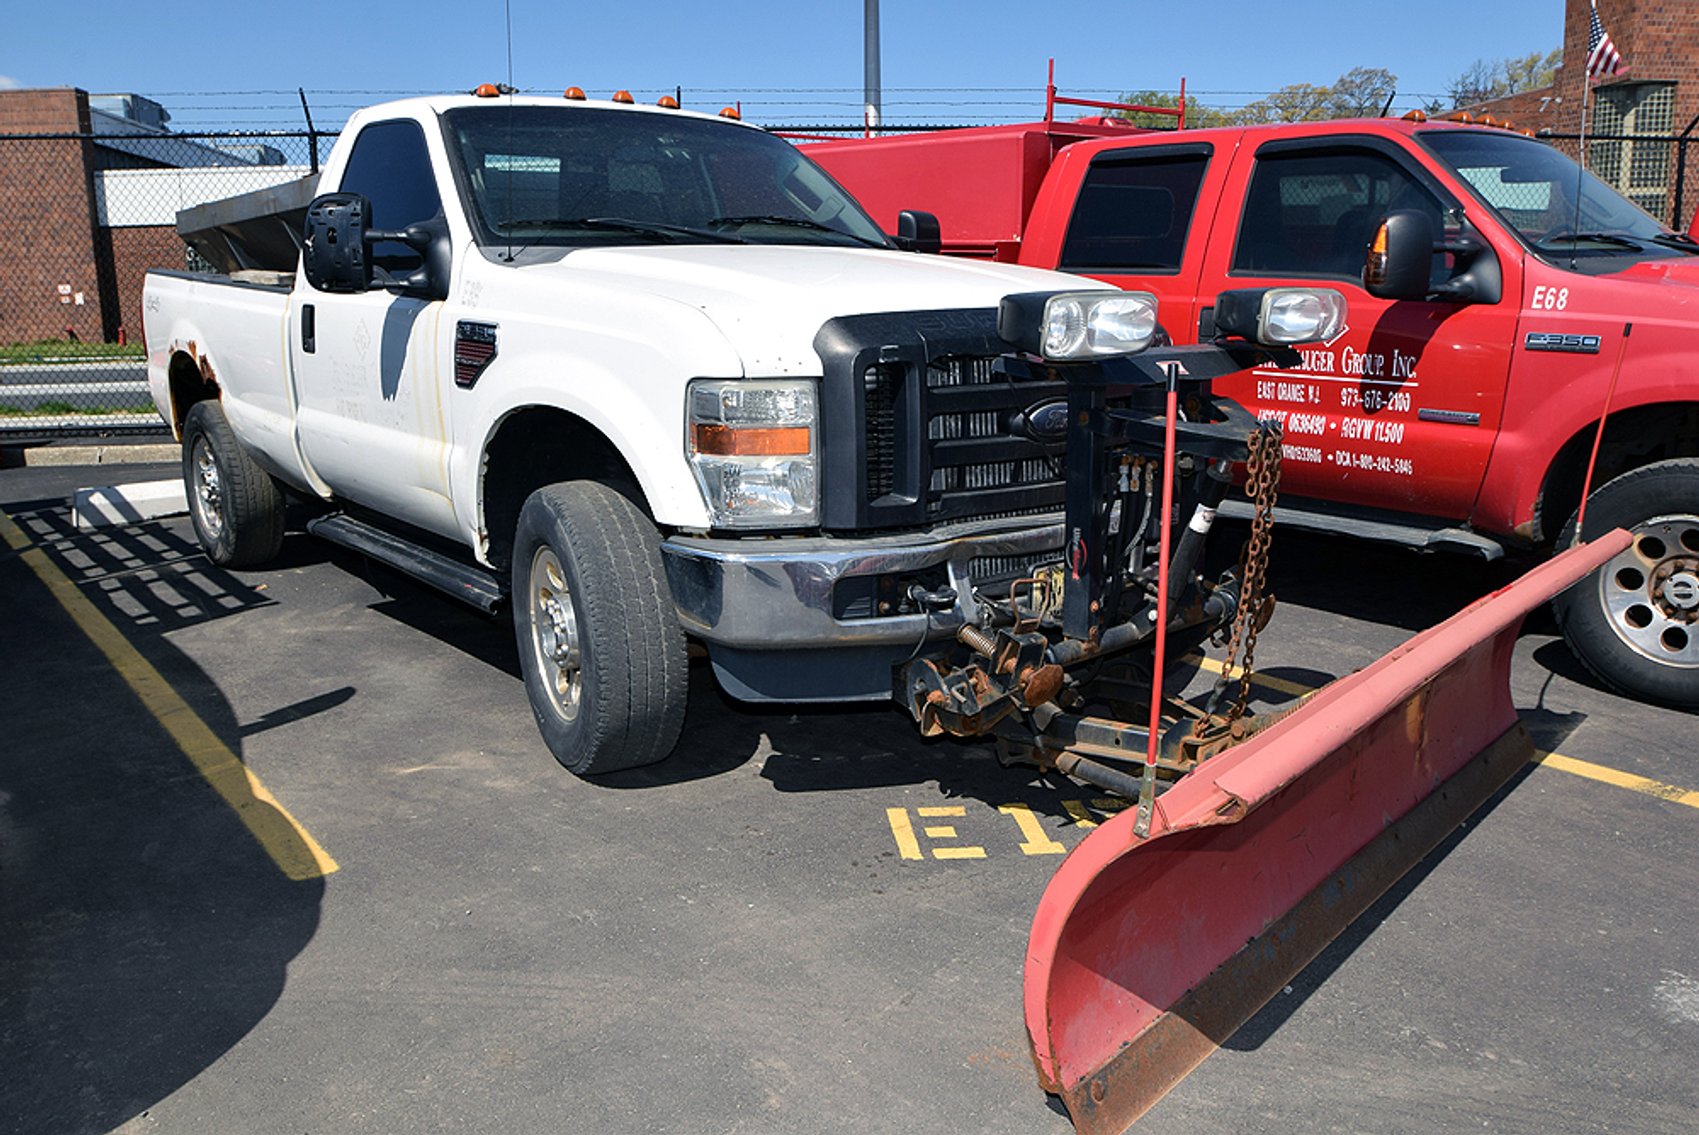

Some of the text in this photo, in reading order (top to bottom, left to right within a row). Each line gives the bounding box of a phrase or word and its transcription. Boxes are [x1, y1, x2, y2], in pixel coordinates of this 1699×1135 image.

[1531, 285, 1569, 310] E68
[1257, 380, 1276, 400] EAST
[1340, 387, 1410, 412] 973-676-2100
